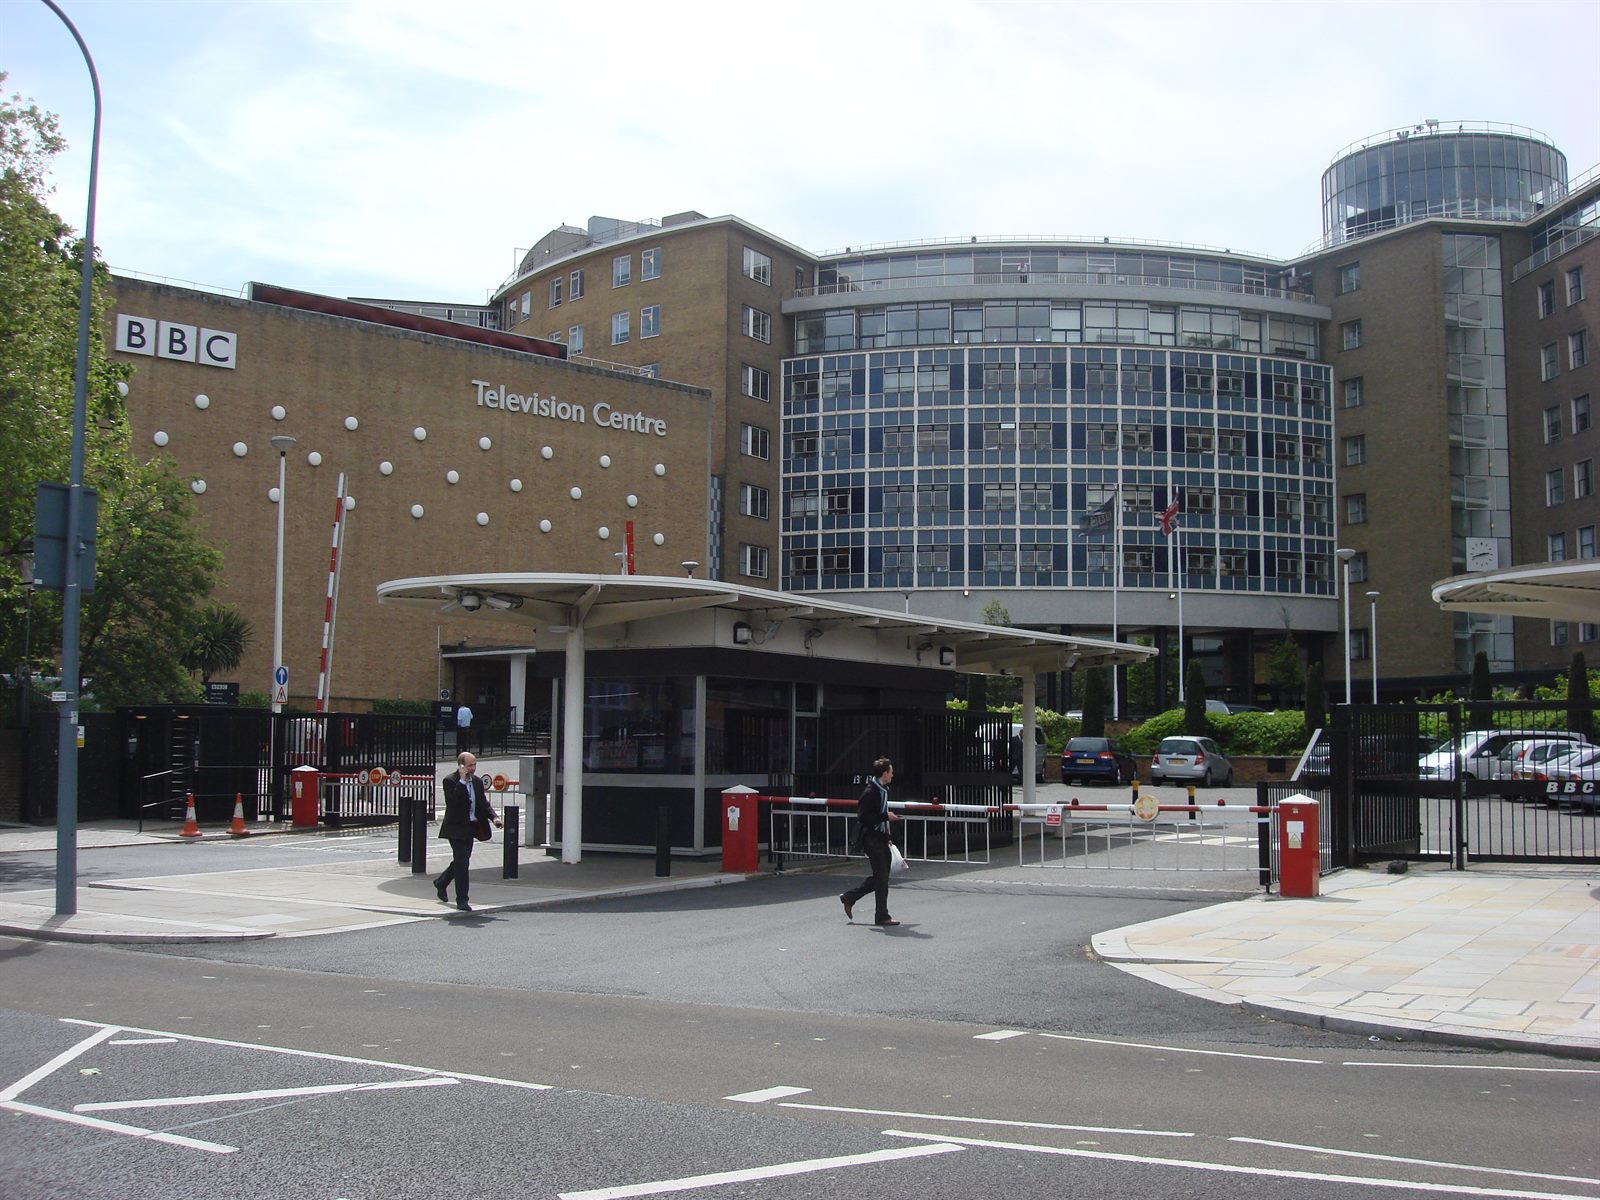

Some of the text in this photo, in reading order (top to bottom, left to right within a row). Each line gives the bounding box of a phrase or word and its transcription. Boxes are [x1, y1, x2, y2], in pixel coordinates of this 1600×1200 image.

[126, 320, 231, 363] BBC
[471, 379, 667, 437] Television Centre
[1546, 781, 1594, 793] BBC
